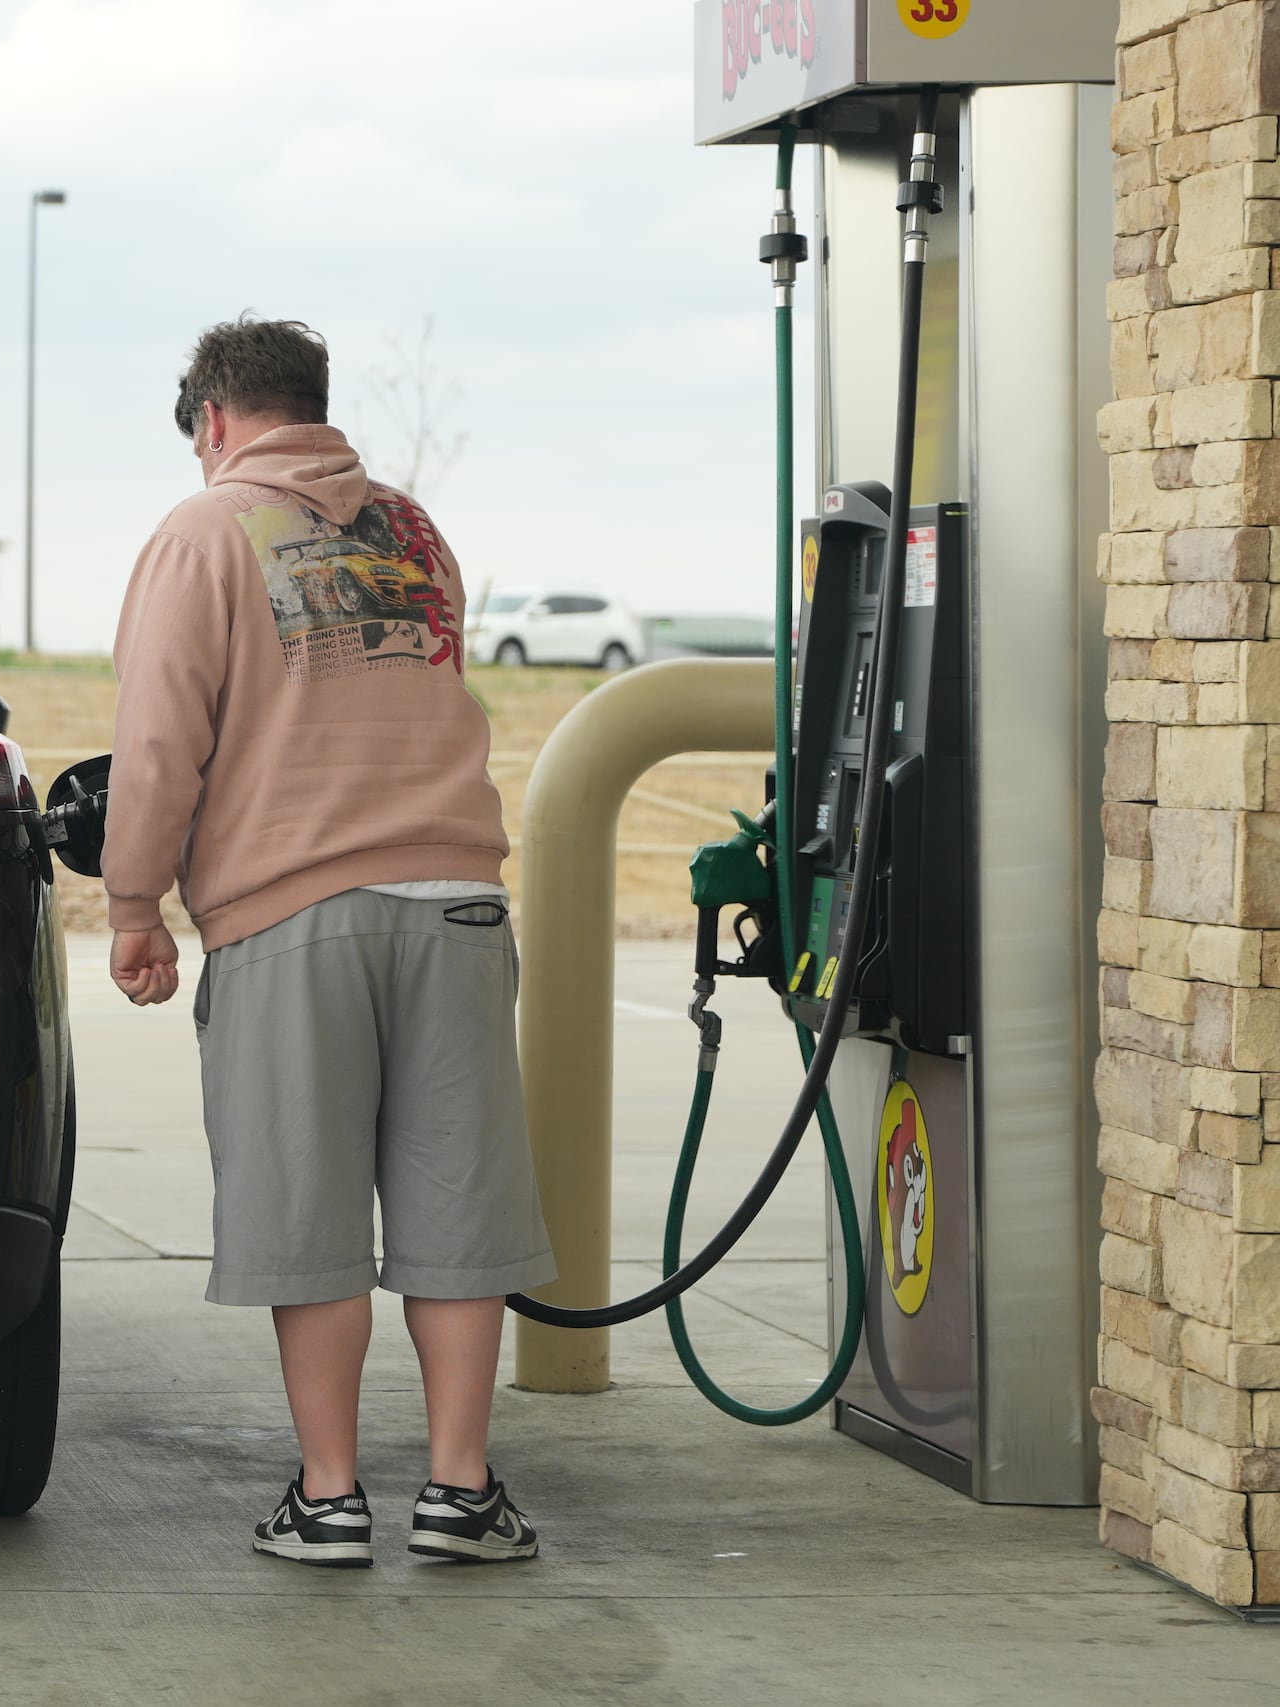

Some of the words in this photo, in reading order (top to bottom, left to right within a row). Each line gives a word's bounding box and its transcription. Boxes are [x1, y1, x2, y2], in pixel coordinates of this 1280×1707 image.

[280, 637, 303, 650] THE
[306, 630, 335, 642] RISING
[338, 626, 358, 636] SUN
[283, 648, 304, 660] THE
[307, 640, 336, 653] RISING
[340, 636, 360, 647] SUN
[284, 657, 305, 670] THE
[309, 650, 338, 663] RISING
[341, 647, 363, 657] SUN
[286, 667, 306, 679] THE
[310, 660, 340, 672] RISING
[343, 656, 366, 667] SUN
[344, 1498, 364, 1508] NIKE
[424, 1487, 446, 1498] NIKE
